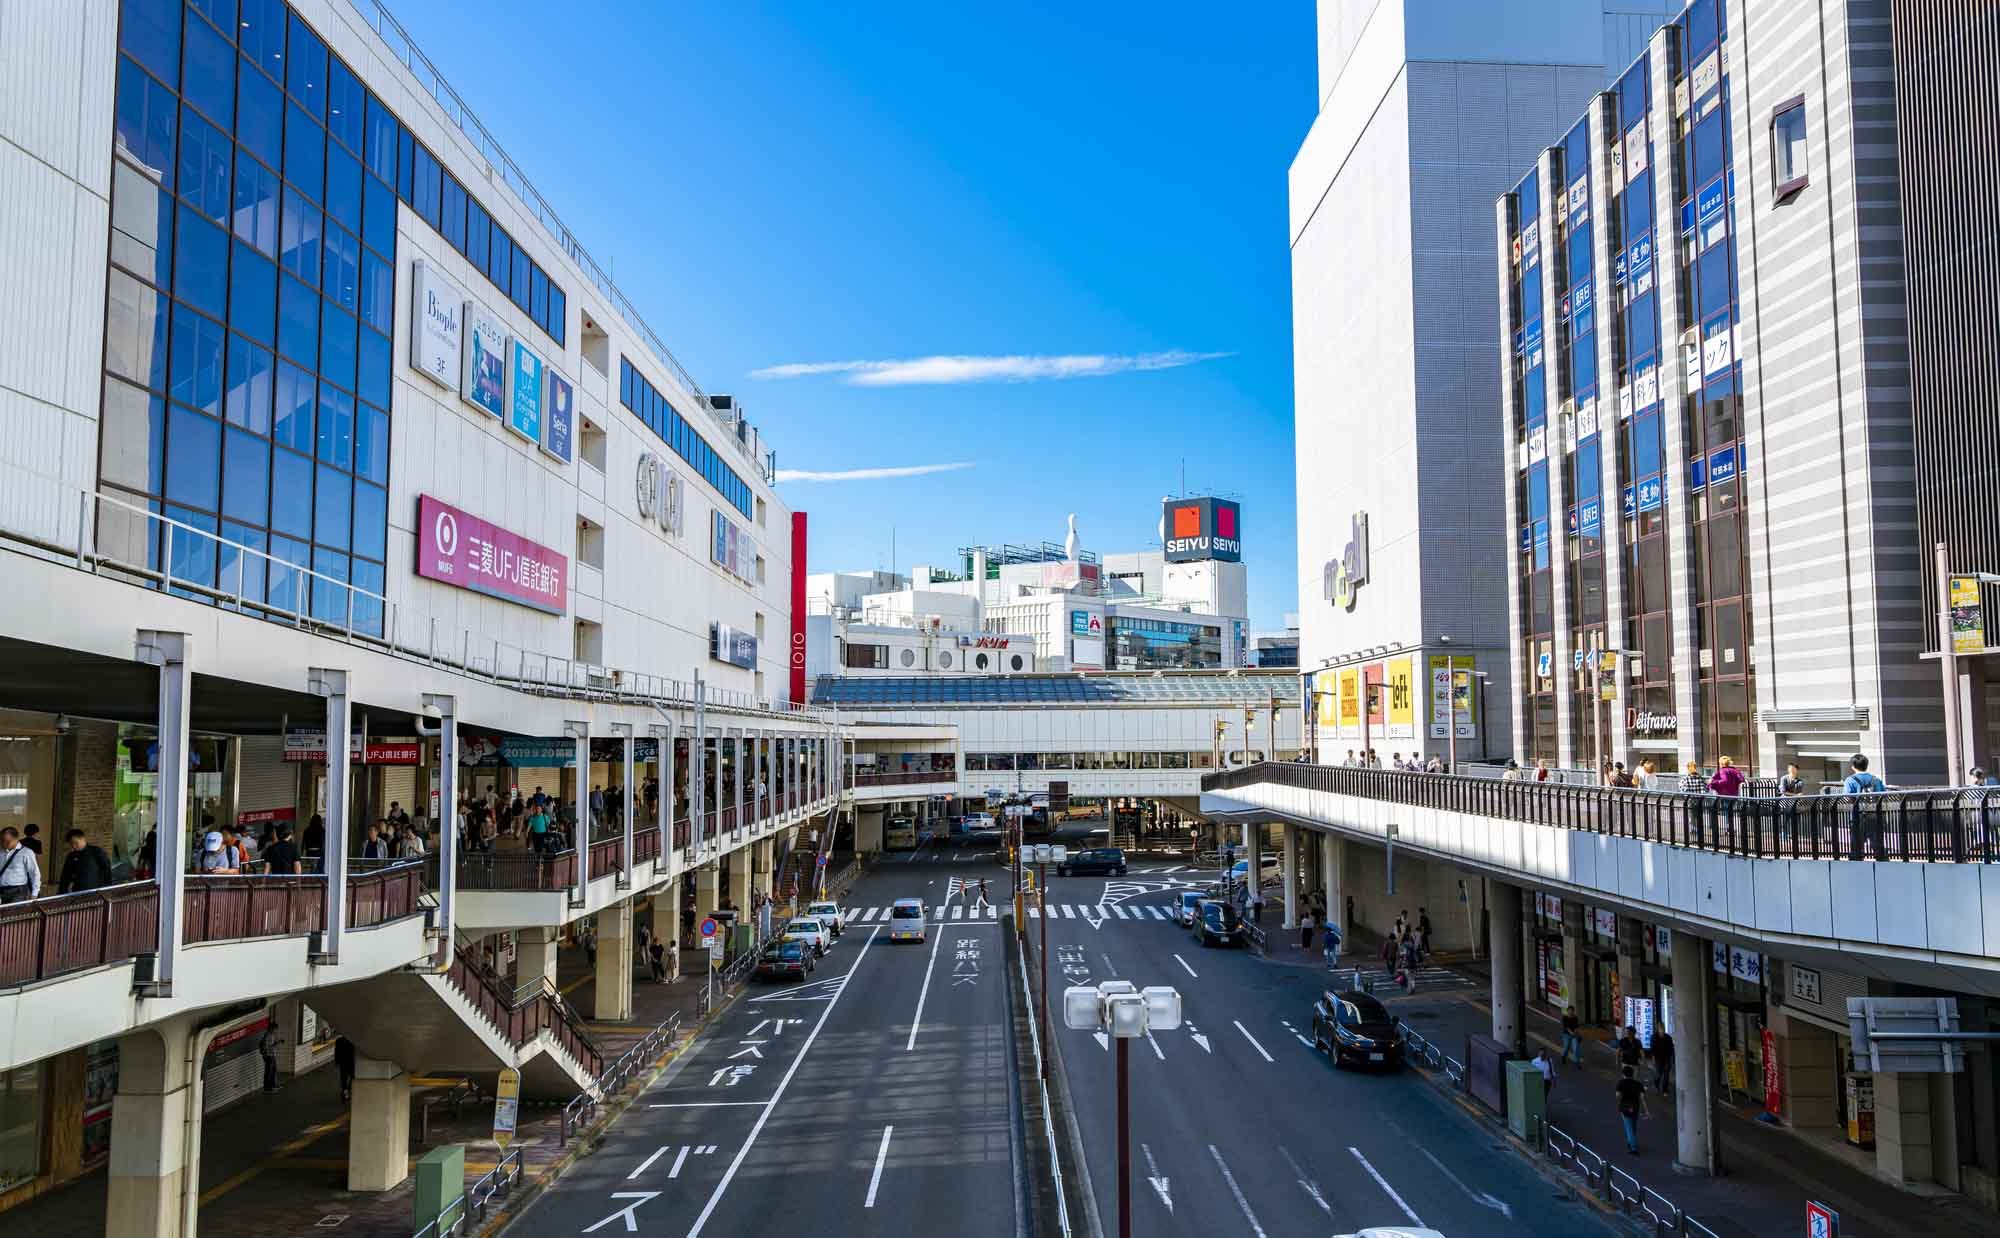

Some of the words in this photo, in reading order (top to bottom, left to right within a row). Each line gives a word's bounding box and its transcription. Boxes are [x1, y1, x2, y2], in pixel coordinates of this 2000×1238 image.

[427, 289, 457, 332] Biople
[437, 357, 447, 376] 3F
[483, 392, 492, 408] 4F
[1582, 504, 1598, 526] 朝日
[1167, 537, 1208, 553] SEIYU
[1213, 537, 1240, 553] SEIYU
[468, 536, 559, 597] 三菱UFJ信託銀行
[581, 1145, 718, 1233] バス
